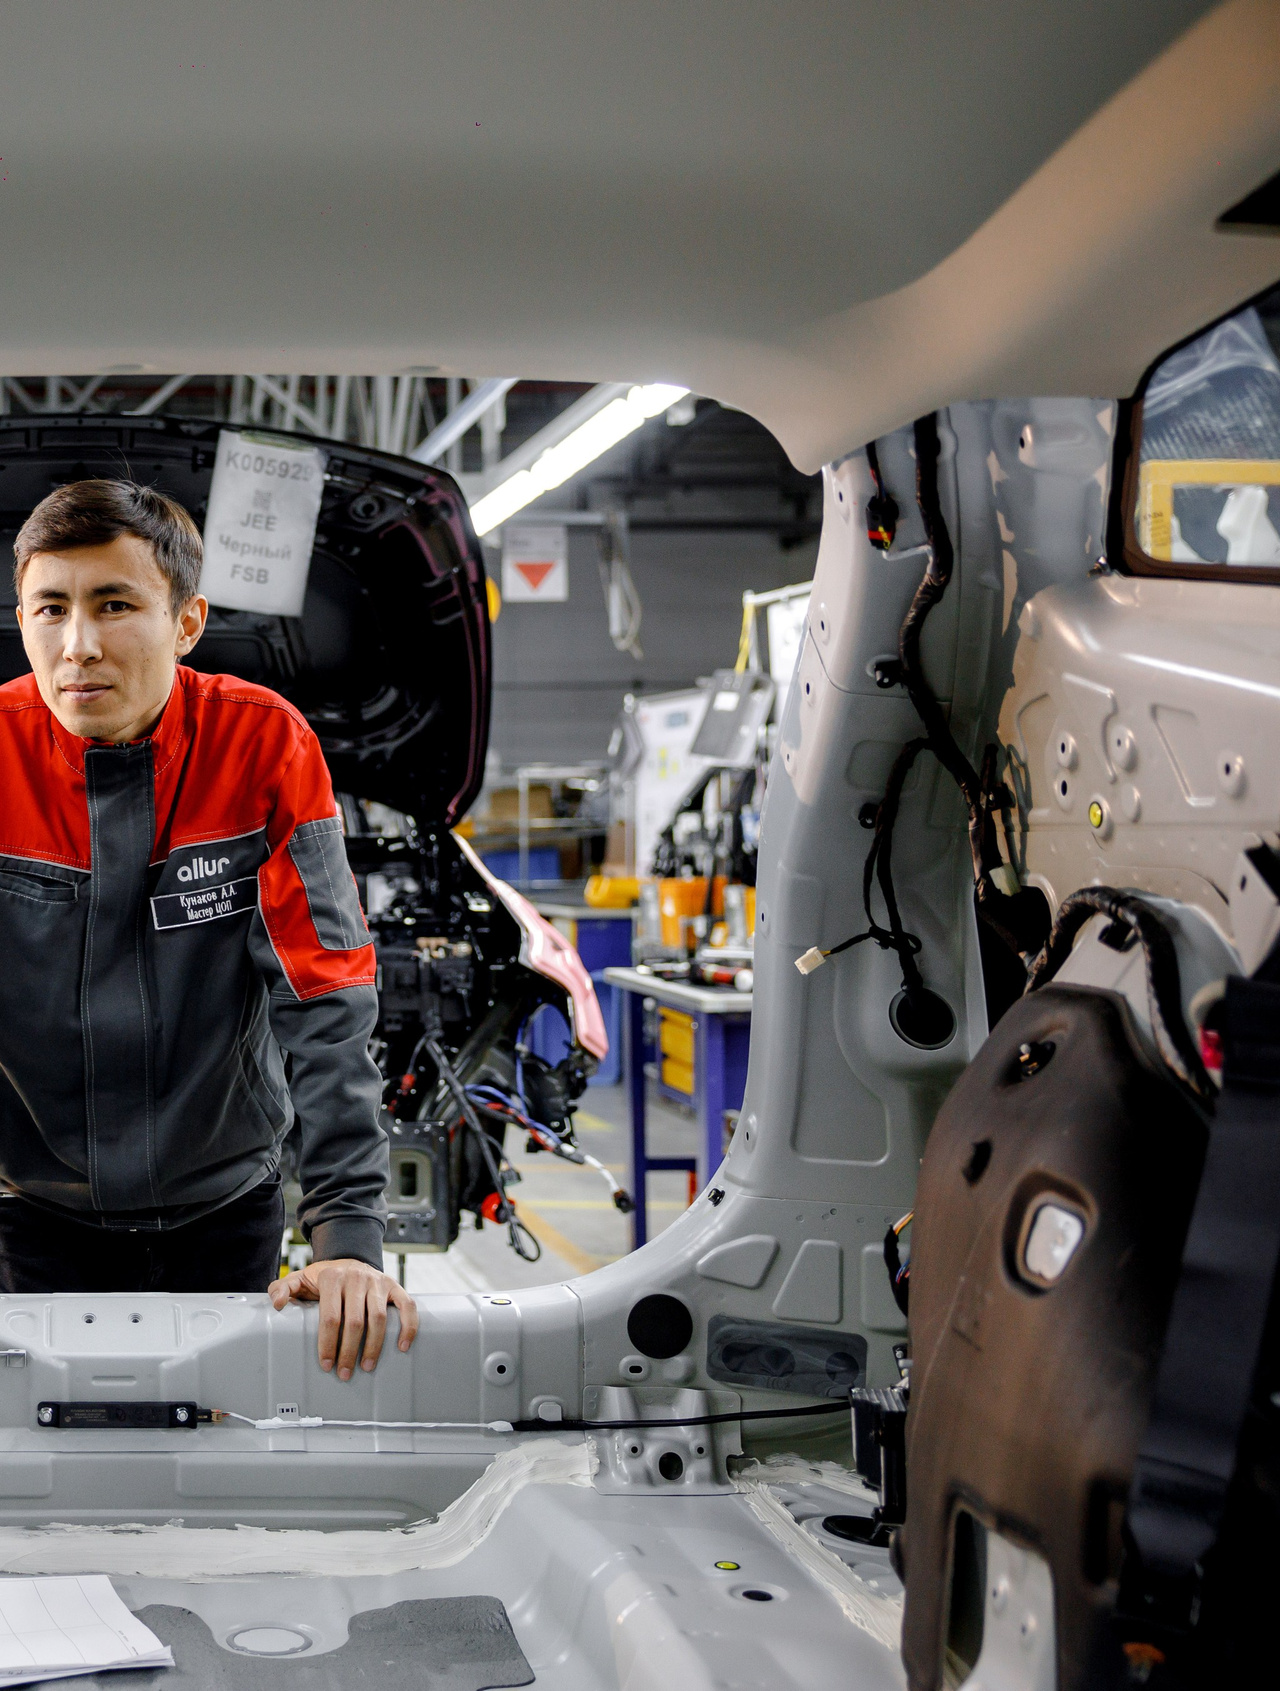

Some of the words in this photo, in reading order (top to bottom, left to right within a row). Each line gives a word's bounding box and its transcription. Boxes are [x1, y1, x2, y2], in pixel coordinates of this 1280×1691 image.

[240, 513, 278, 532] JEE
[219, 533, 292, 560] Черный
[230, 564, 269, 584] FSB
[177, 857, 230, 882] allur
[187, 906, 214, 921] Мастер
[215, 900, 233, 916] ЦОП
